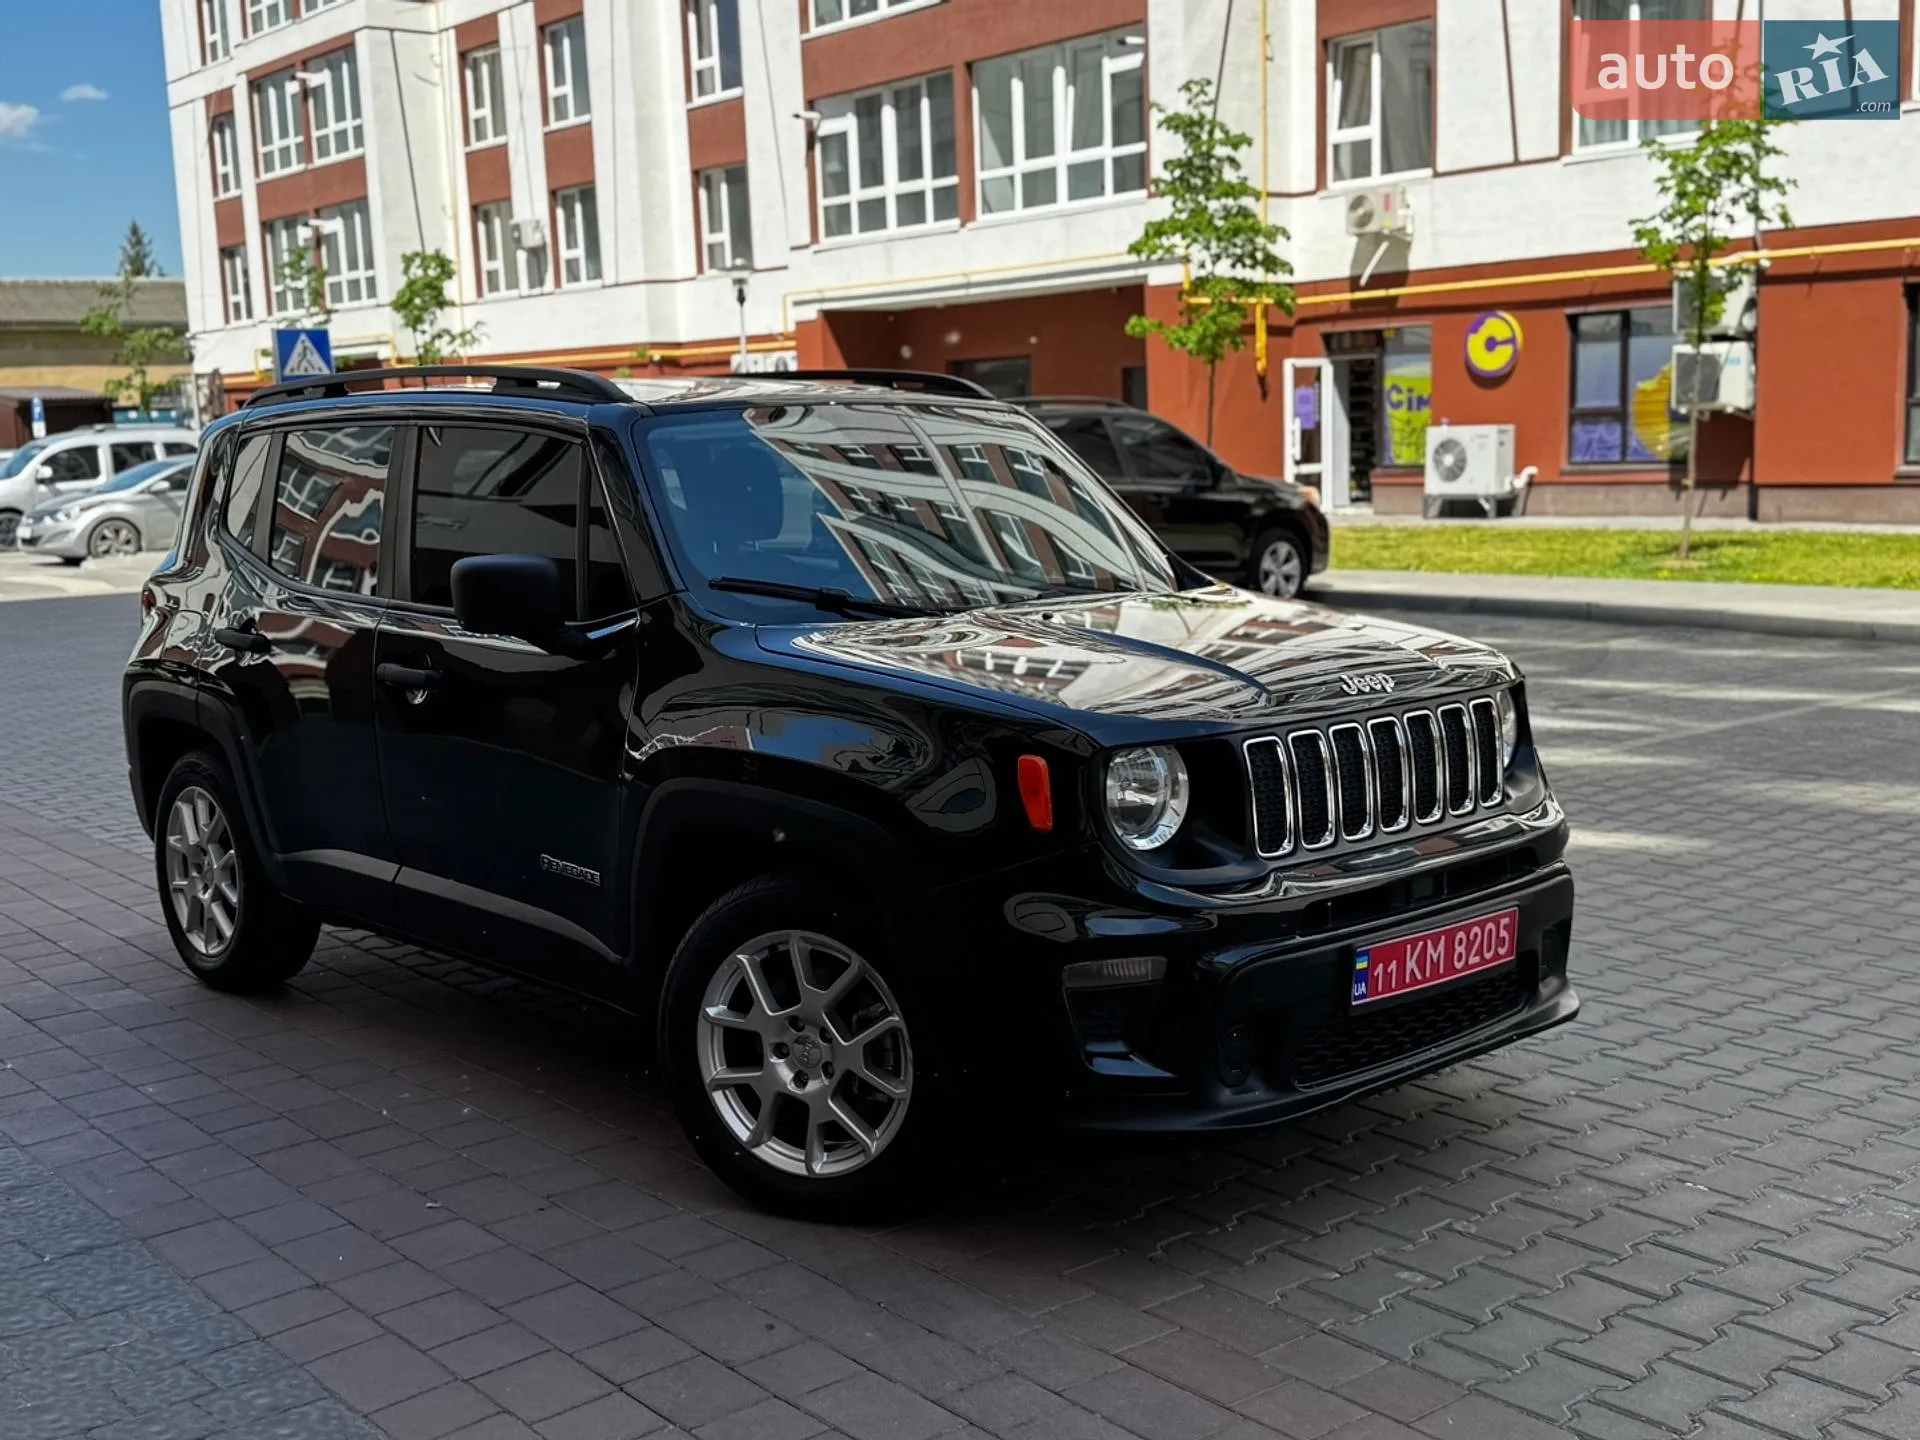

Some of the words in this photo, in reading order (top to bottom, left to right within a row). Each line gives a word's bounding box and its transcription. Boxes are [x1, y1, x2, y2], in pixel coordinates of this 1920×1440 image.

[1339, 673, 1395, 695] Jeep
[540, 853, 601, 887] RENEGADE
[1374, 959, 1397, 993] 11
[1405, 934, 1446, 984] KM
[1453, 916, 1511, 970] 8205
[1354, 981, 1367, 996] UA
